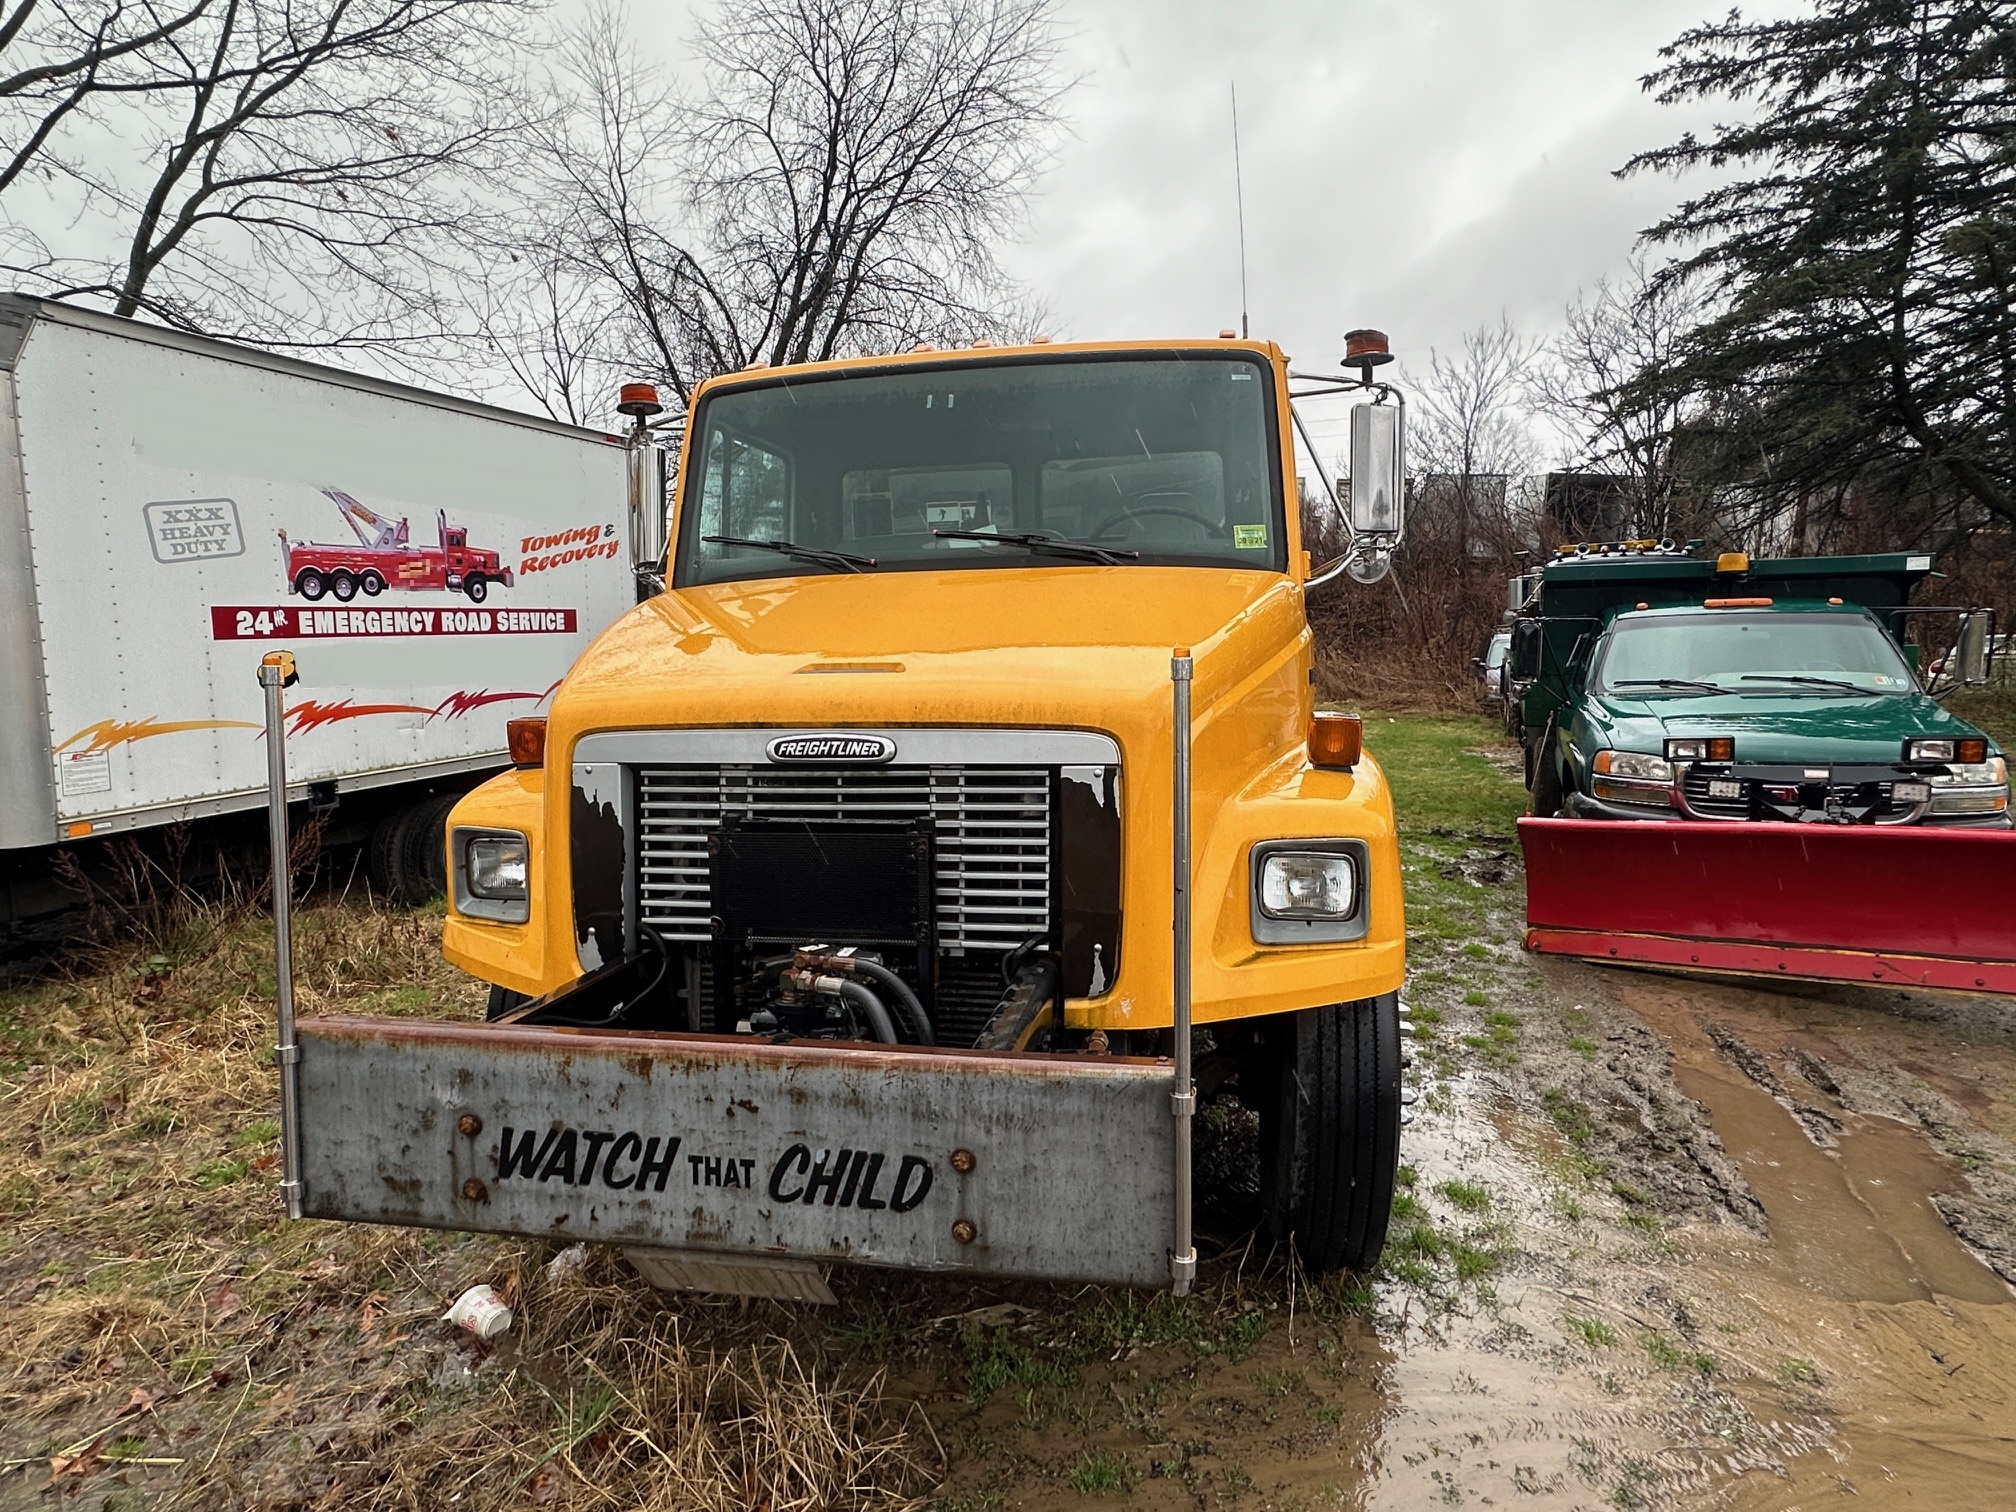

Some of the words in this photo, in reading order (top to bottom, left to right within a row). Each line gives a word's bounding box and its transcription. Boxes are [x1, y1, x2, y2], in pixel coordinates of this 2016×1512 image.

[162, 507, 225, 523] XXX
[159, 523, 232, 541] HEAVY
[521, 525, 601, 554] Towing
[603, 523, 615, 537] &
[170, 539, 227, 555] DUTY
[520, 539, 619, 575] Recovery
[298, 610, 435, 634] EMERGENCY
[441, 611, 492, 632] ROAD
[496, 611, 565, 632] SERVICE
[778, 740, 880, 756] FREIGHTLINER
[499, 1126, 682, 1192] WATCH
[688, 1154, 756, 1188] THAT
[768, 1142, 934, 1213] CHILD
